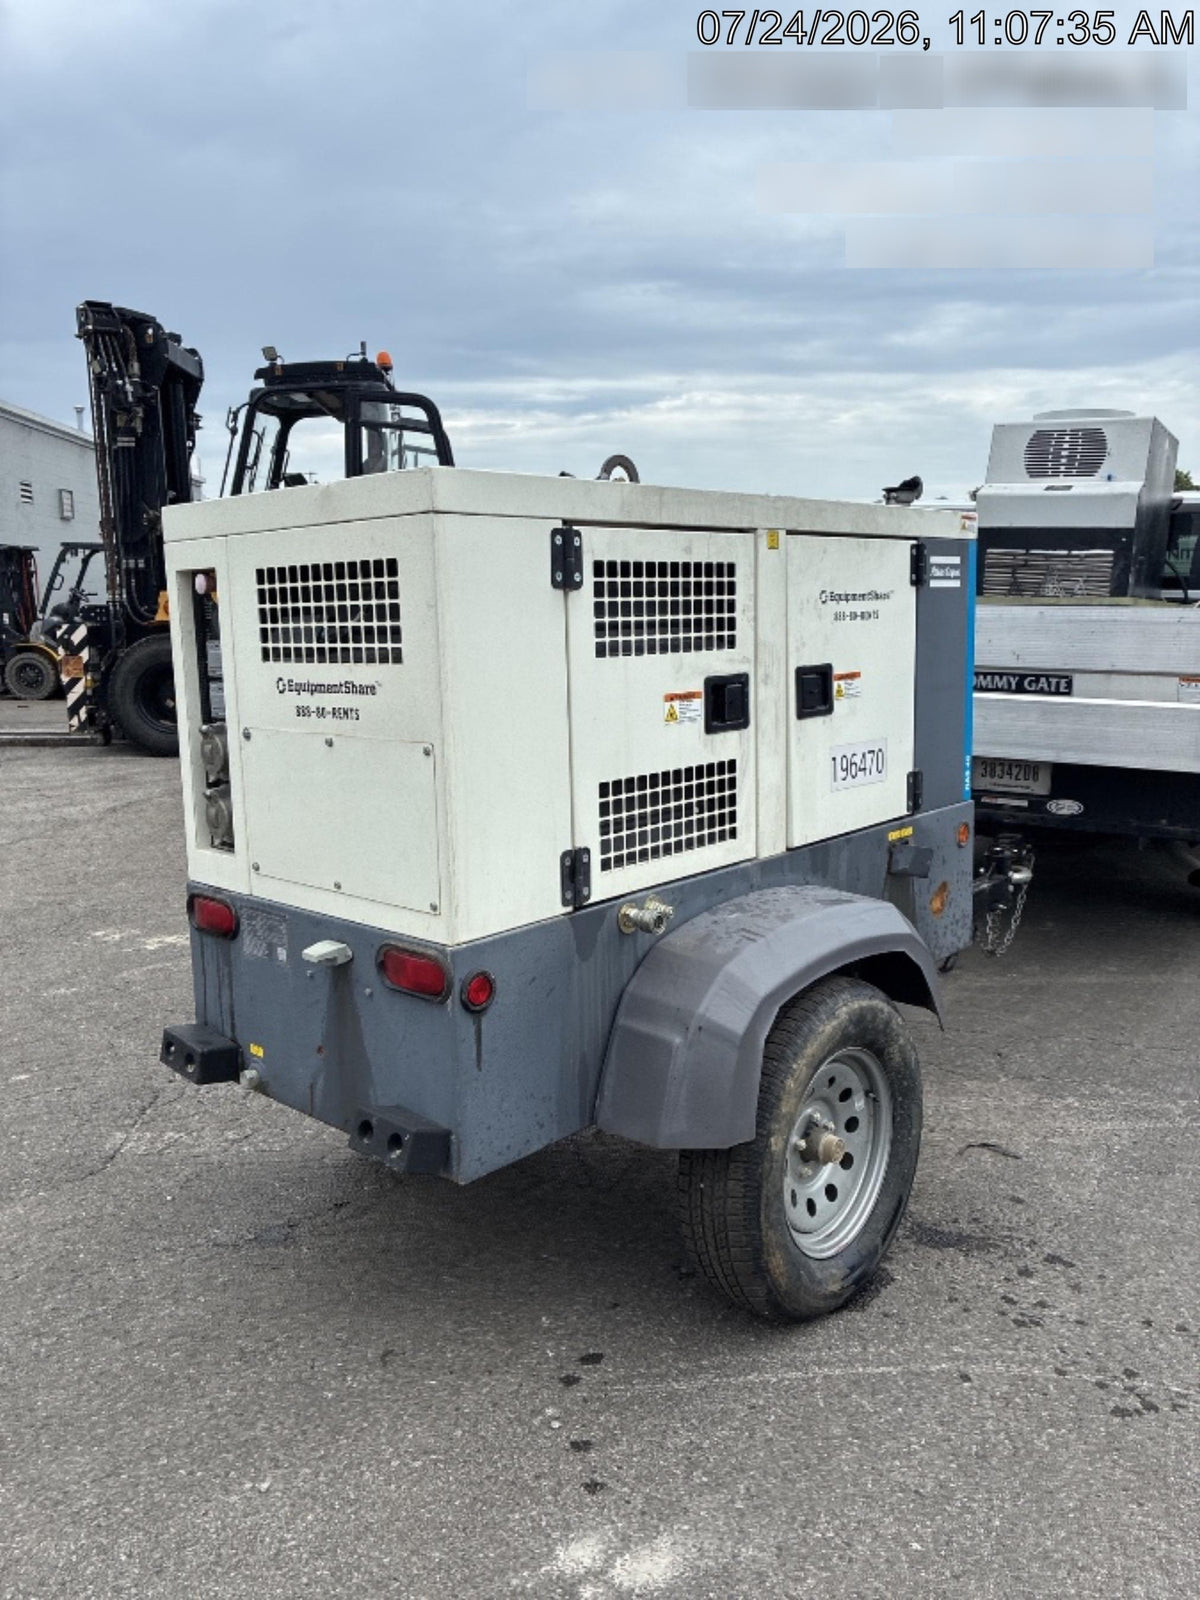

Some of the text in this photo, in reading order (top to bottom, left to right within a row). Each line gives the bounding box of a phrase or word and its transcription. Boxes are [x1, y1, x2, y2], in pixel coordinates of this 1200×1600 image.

[287, 679, 377, 696] EquipmentShare
[1023, 676, 1069, 692] GATE
[831, 748, 885, 783] 196470
